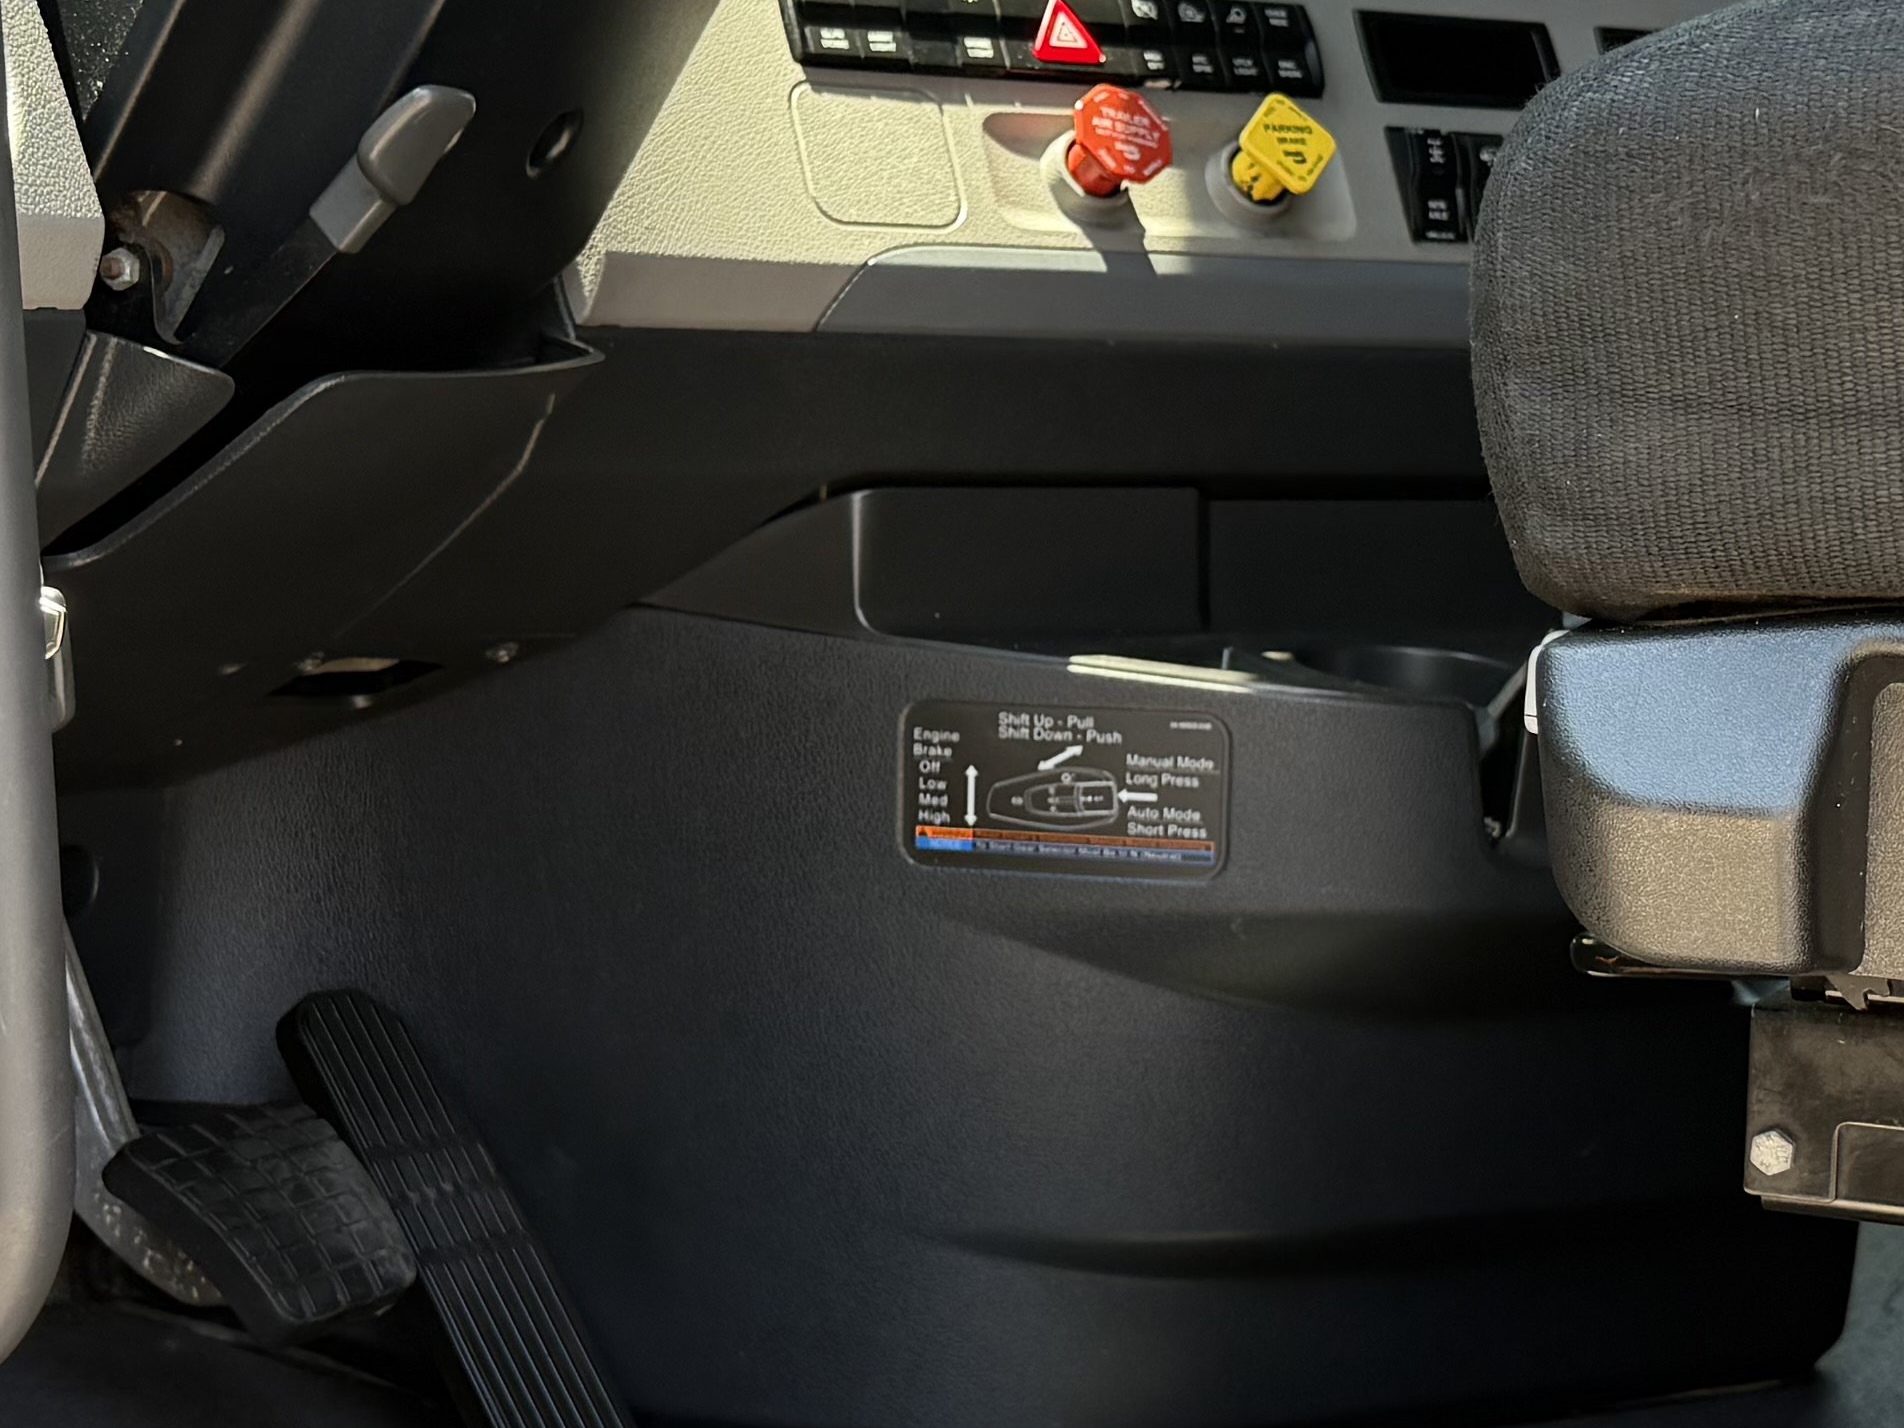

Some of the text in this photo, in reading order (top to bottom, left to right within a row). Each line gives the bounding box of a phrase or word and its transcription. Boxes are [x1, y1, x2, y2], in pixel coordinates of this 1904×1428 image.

[1263, 123, 1313, 136] PARKING
[998, 712, 1030, 726] Shift
[1034, 714, 1054, 729] Up
[1067, 715, 1095, 728] Pull
[913, 727, 960, 743] Engine
[998, 726, 1029, 740] Shift
[1033, 728, 1072, 741] Down
[1086, 731, 1123, 744] Push
[913, 743, 952, 757] Brake
[919, 760, 941, 774] Off
[1126, 754, 1215, 770] Manual Mode
[919, 777, 947, 790] Low
[1126, 773, 1200, 789] Long Press
[919, 793, 948, 807] Med
[918, 810, 951, 826] High
[1127, 806, 1201, 821] Auto Mode
[1127, 824, 1207, 838] Short Press
